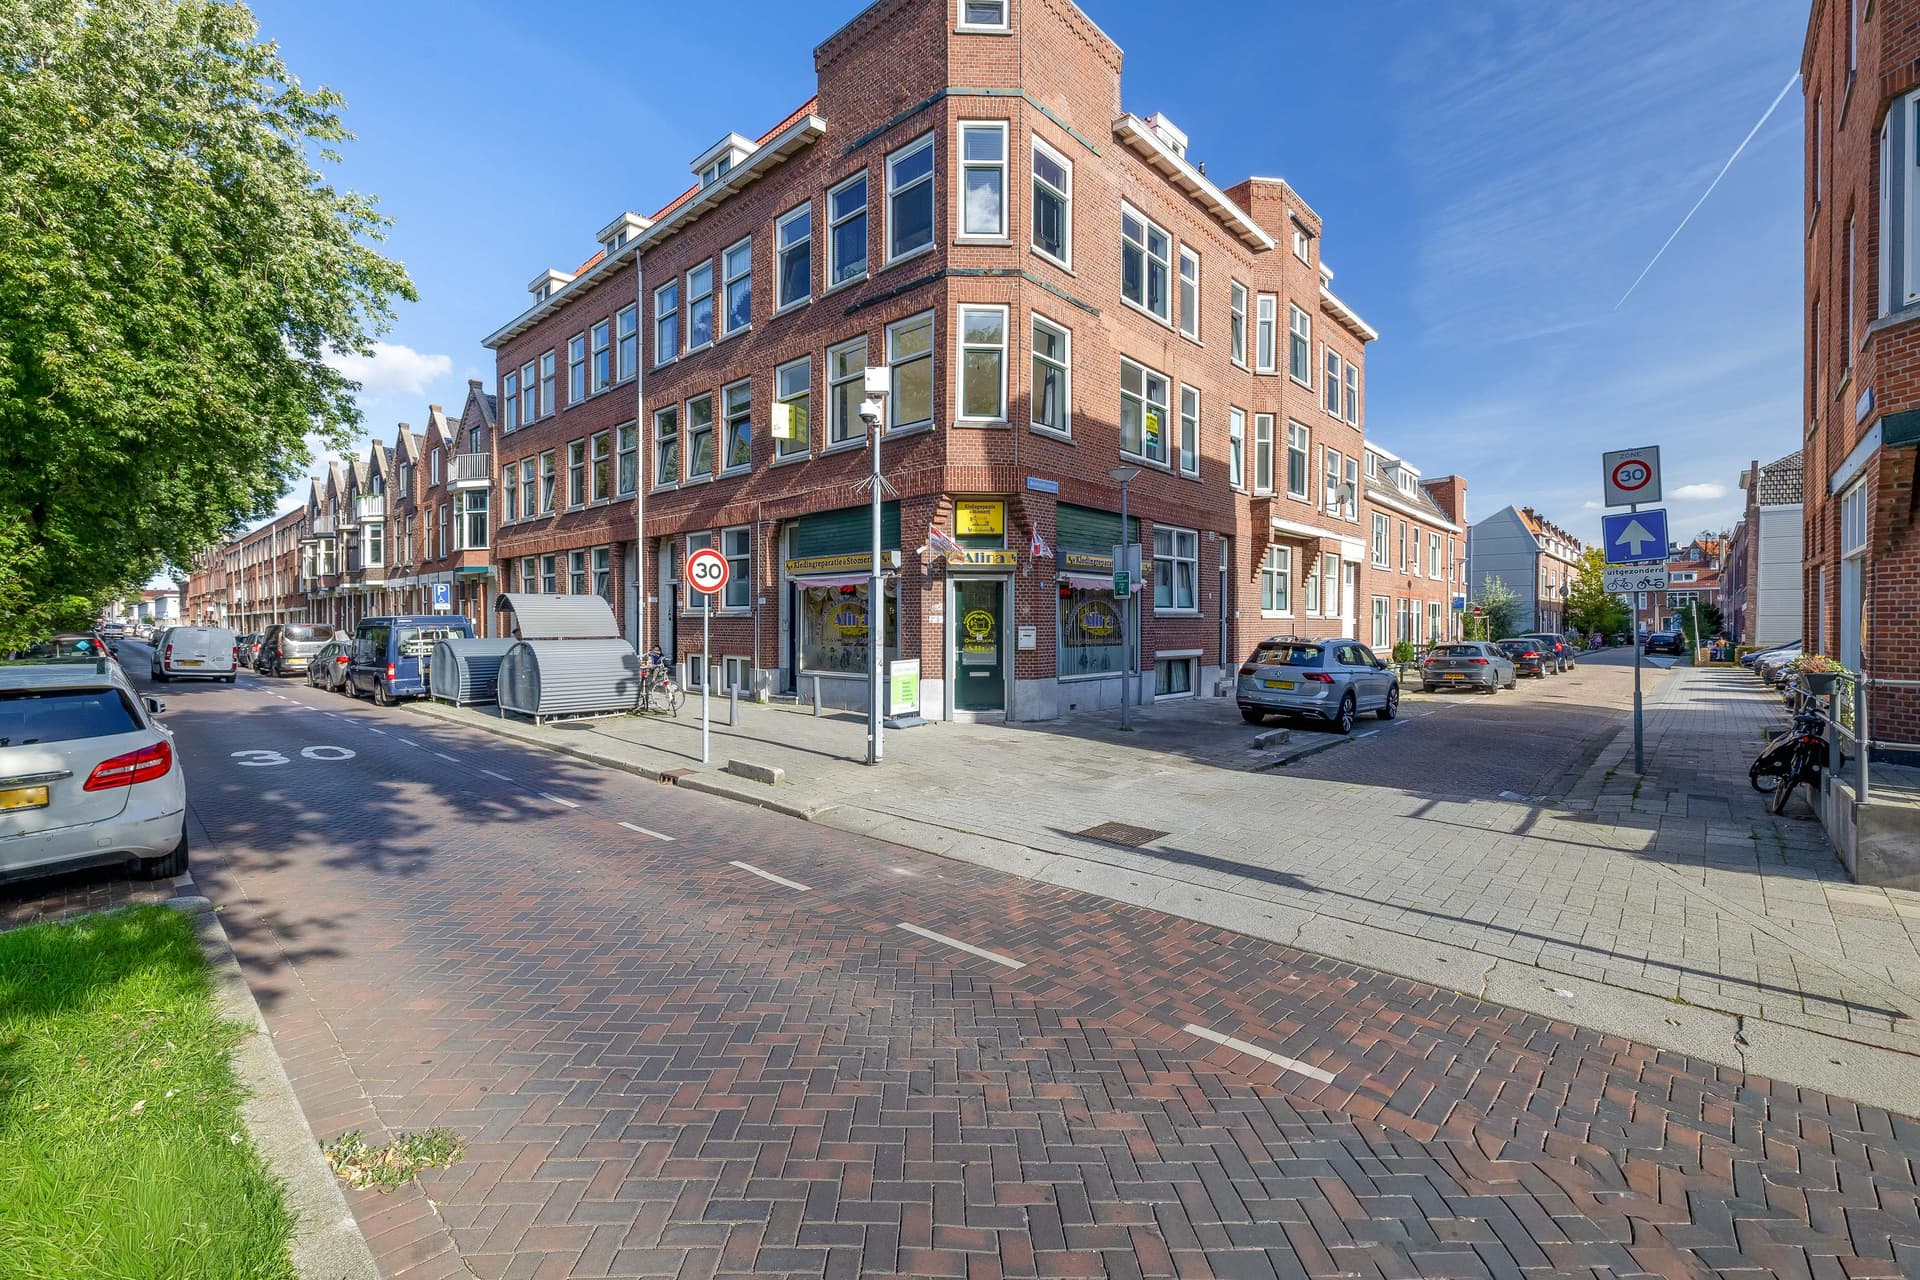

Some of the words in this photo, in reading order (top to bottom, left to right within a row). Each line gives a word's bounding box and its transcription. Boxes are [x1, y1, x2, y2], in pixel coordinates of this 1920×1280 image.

[1619, 451, 1642, 459] ZONE
[1620, 468, 1644, 482] 30
[847, 556, 873, 565] Stomeri
[965, 552, 1005, 563] Alina
[695, 562, 721, 579] 30
[1607, 567, 1664, 576] uitgezonderd
[437, 585, 446, 596] P
[230, 746, 356, 766] 30
